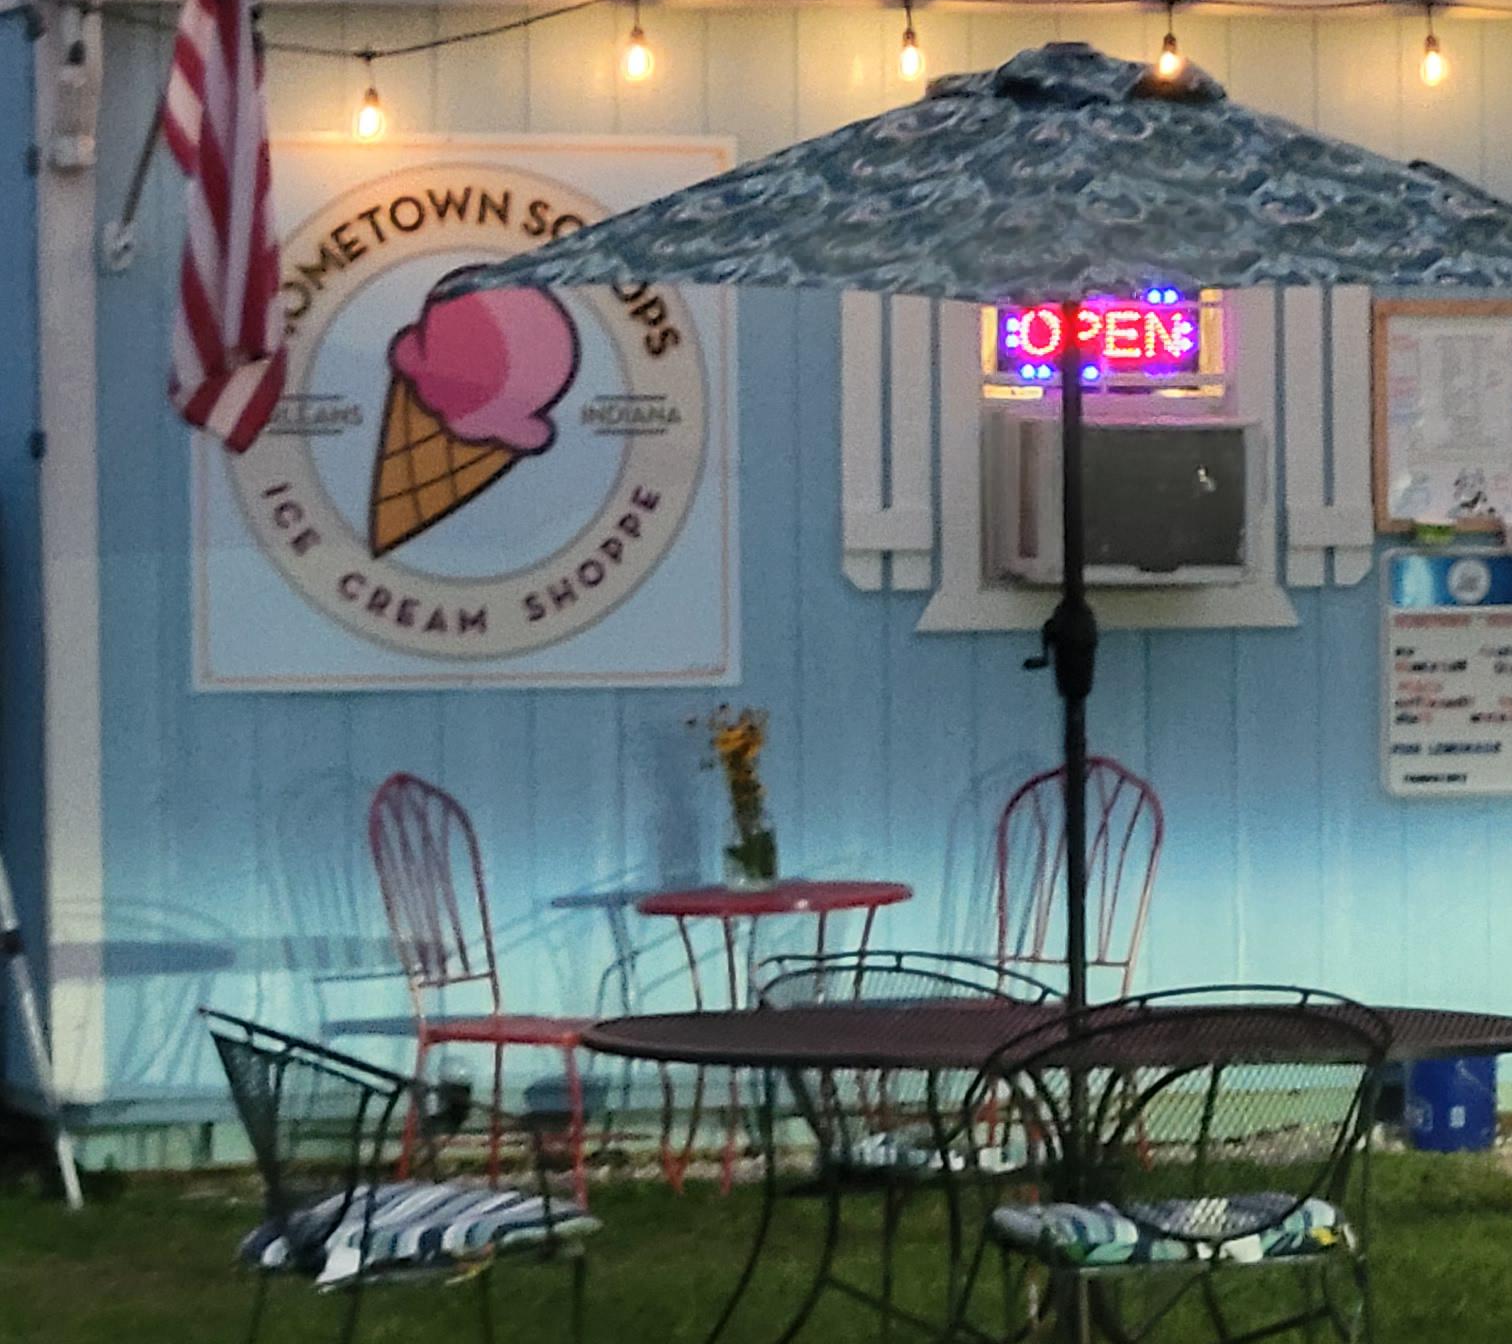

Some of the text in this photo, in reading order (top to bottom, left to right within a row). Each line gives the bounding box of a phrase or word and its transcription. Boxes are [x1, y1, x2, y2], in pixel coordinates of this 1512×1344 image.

[283, 187, 511, 336] OMETOWN
[1020, 309, 1184, 358] OPEN
[580, 404, 682, 425] INDIANA
[261, 482, 661, 634] ICE CREAM SHOPPE
